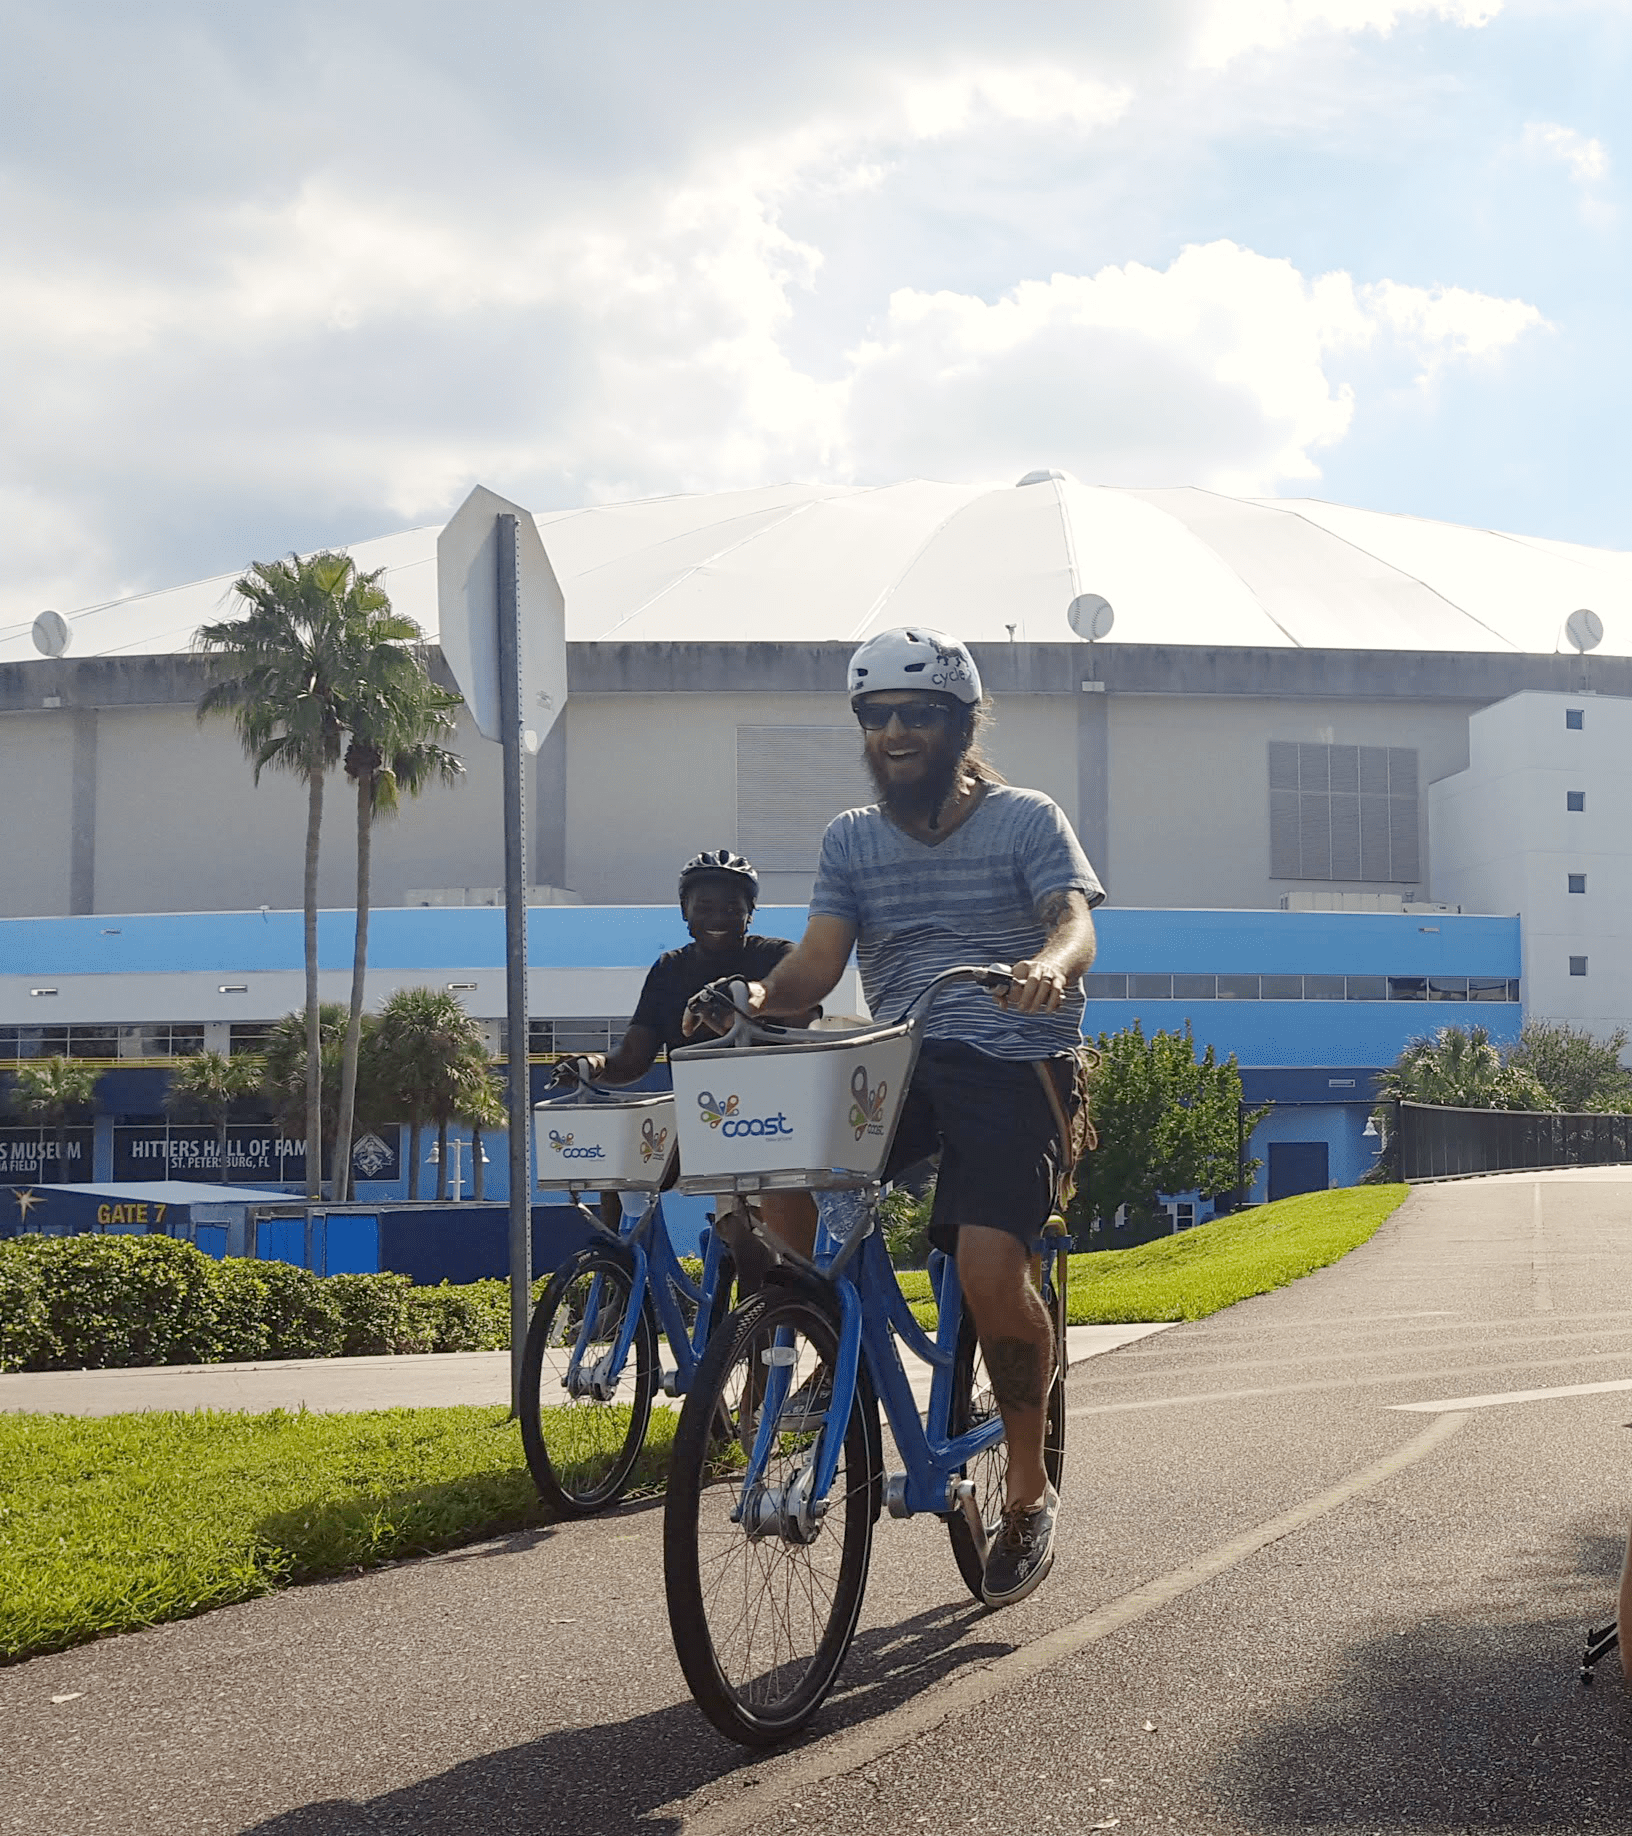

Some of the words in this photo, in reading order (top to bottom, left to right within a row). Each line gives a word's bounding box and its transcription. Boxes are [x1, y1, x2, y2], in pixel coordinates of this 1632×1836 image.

[722, 1112, 793, 1137] coast
[132, 1140, 199, 1158] HITTERS
[249, 1139, 271, 1157] OF
[274, 1138, 308, 1157] FAM
[562, 1144, 606, 1158] coast
[10, 1160, 37, 1172] FIELD
[171, 1157, 186, 1169] ST.
[258, 1156, 271, 1168] FL
[97, 1203, 148, 1224] GATE
[153, 1203, 167, 1223] 7
